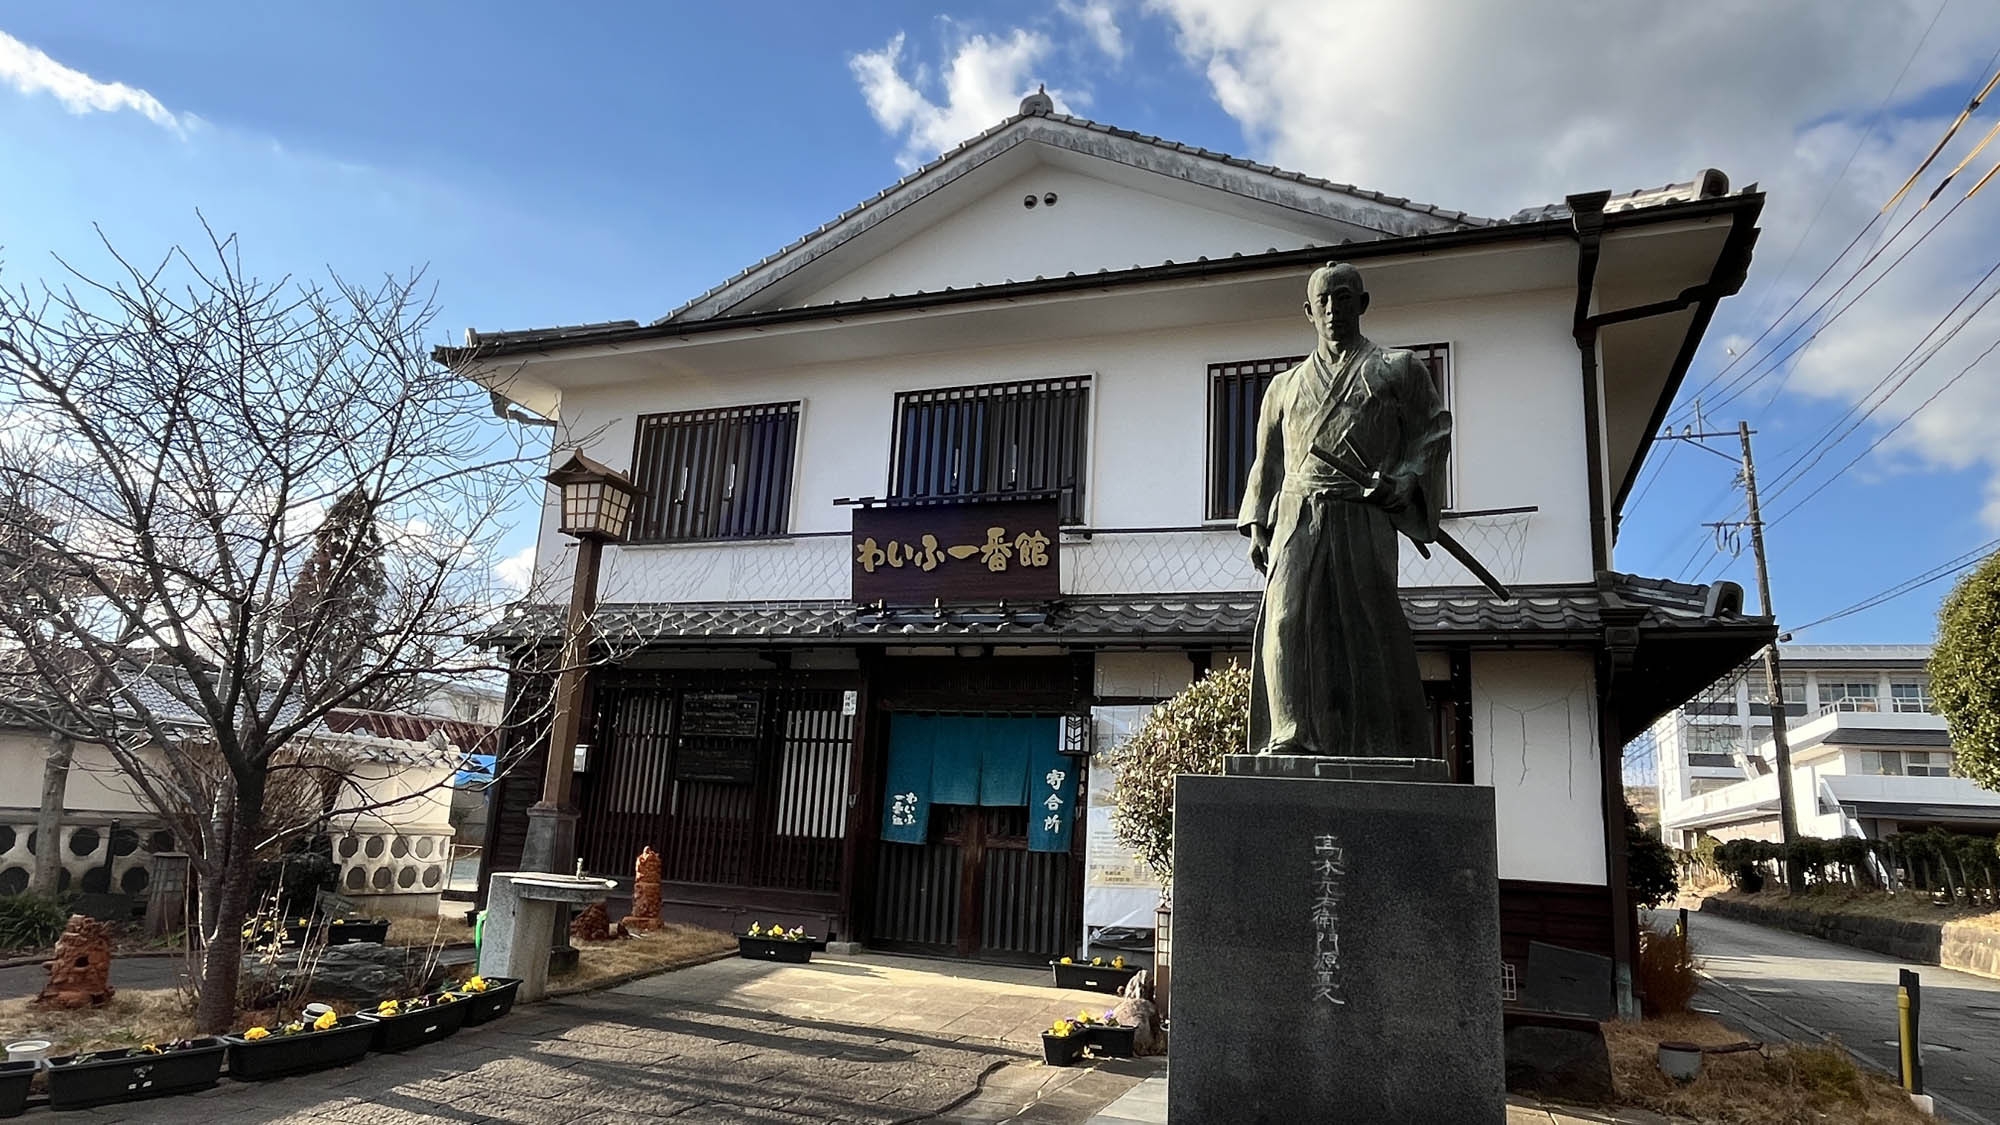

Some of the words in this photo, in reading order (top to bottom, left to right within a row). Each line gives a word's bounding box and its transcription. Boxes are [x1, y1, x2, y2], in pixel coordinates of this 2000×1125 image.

[857, 527, 1050, 573] わいふ一番館
[1043, 769, 1066, 834] 寄合所
